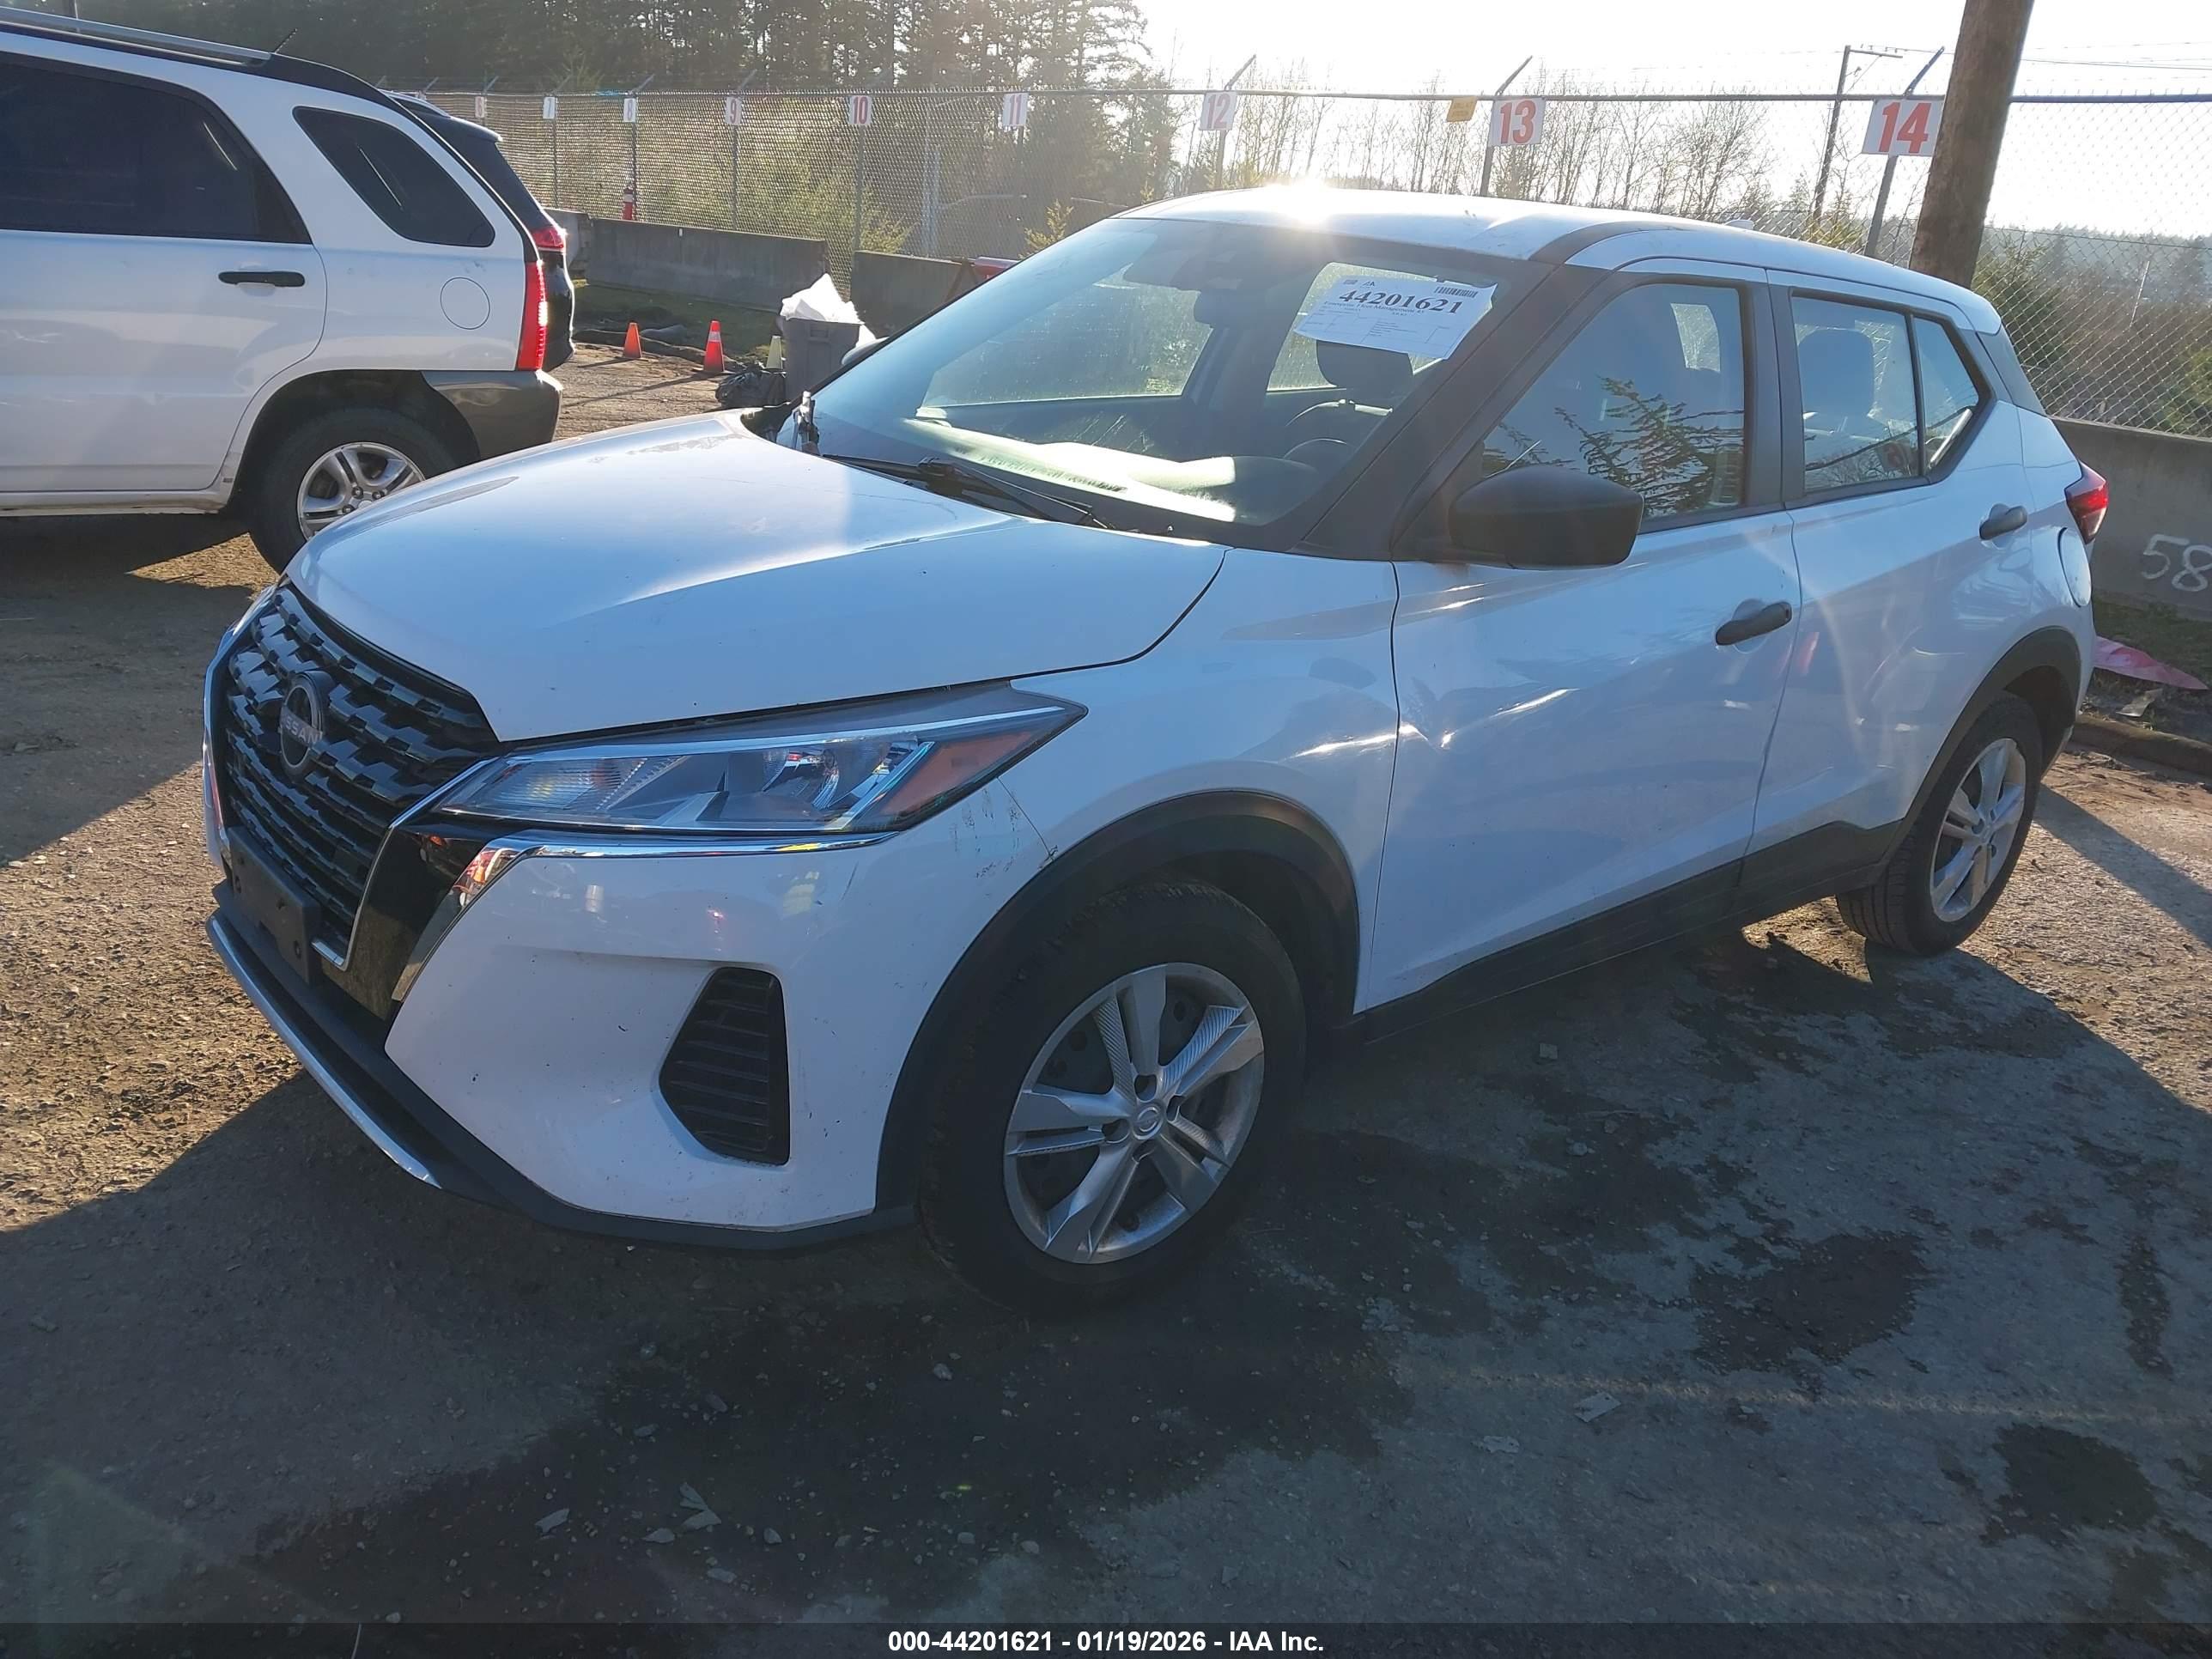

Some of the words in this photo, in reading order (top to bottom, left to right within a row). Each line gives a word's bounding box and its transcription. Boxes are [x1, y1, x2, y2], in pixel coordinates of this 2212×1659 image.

[628, 99, 634, 120] 8
[730, 99, 737, 124] 9
[854, 96, 869, 125] 10
[1009, 94, 1022, 125] 11
[1206, 93, 1231, 129] 12
[1499, 100, 1536, 144] 13
[1878, 101, 1932, 154] 14
[1339, 290, 1463, 314] 44201621
[2141, 533, 2212, 592] 58
